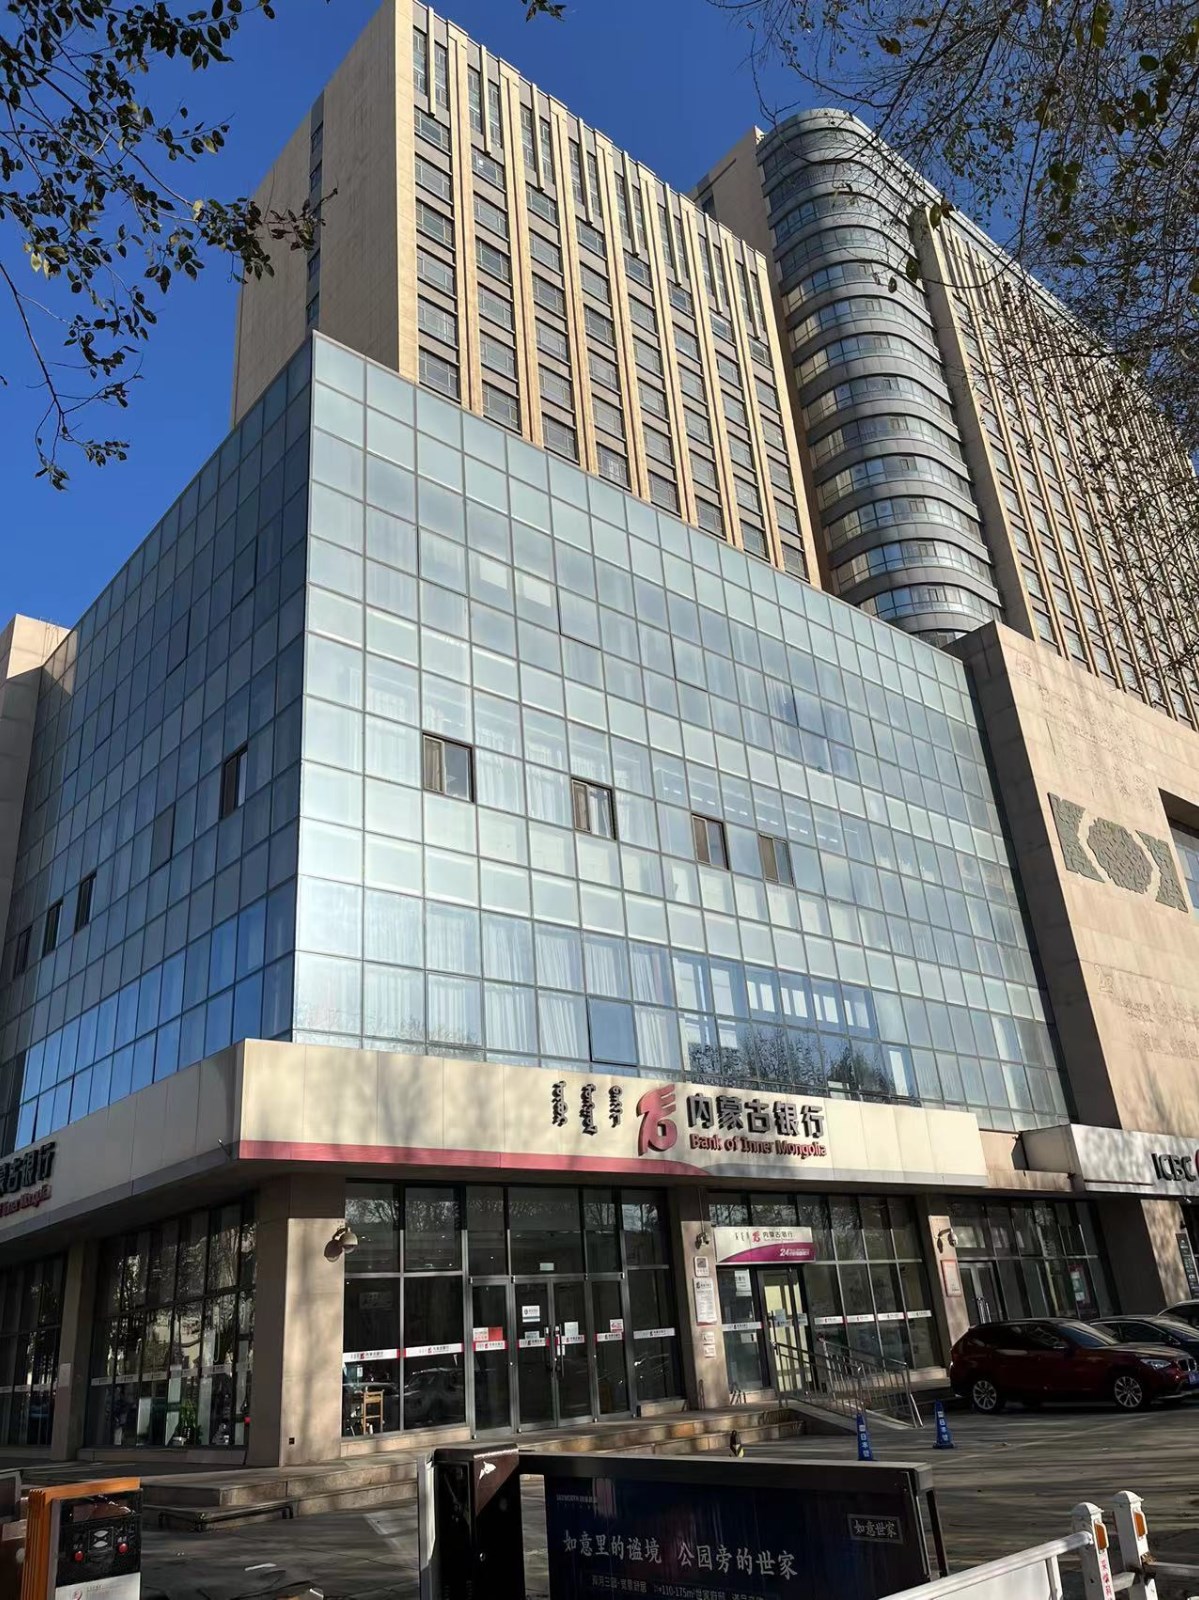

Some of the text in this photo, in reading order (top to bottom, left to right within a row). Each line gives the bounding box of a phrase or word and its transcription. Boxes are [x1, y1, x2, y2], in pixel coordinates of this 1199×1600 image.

[686, 1093, 825, 1138] 内蒙古银行
[689, 1133, 827, 1159] Bank of Inner Mongolia
[1151, 1152, 1197, 1182] ICBC
[853, 1519, 898, 1538] 如意世家
[677, 1540, 798, 1581] 公园旁的世家
